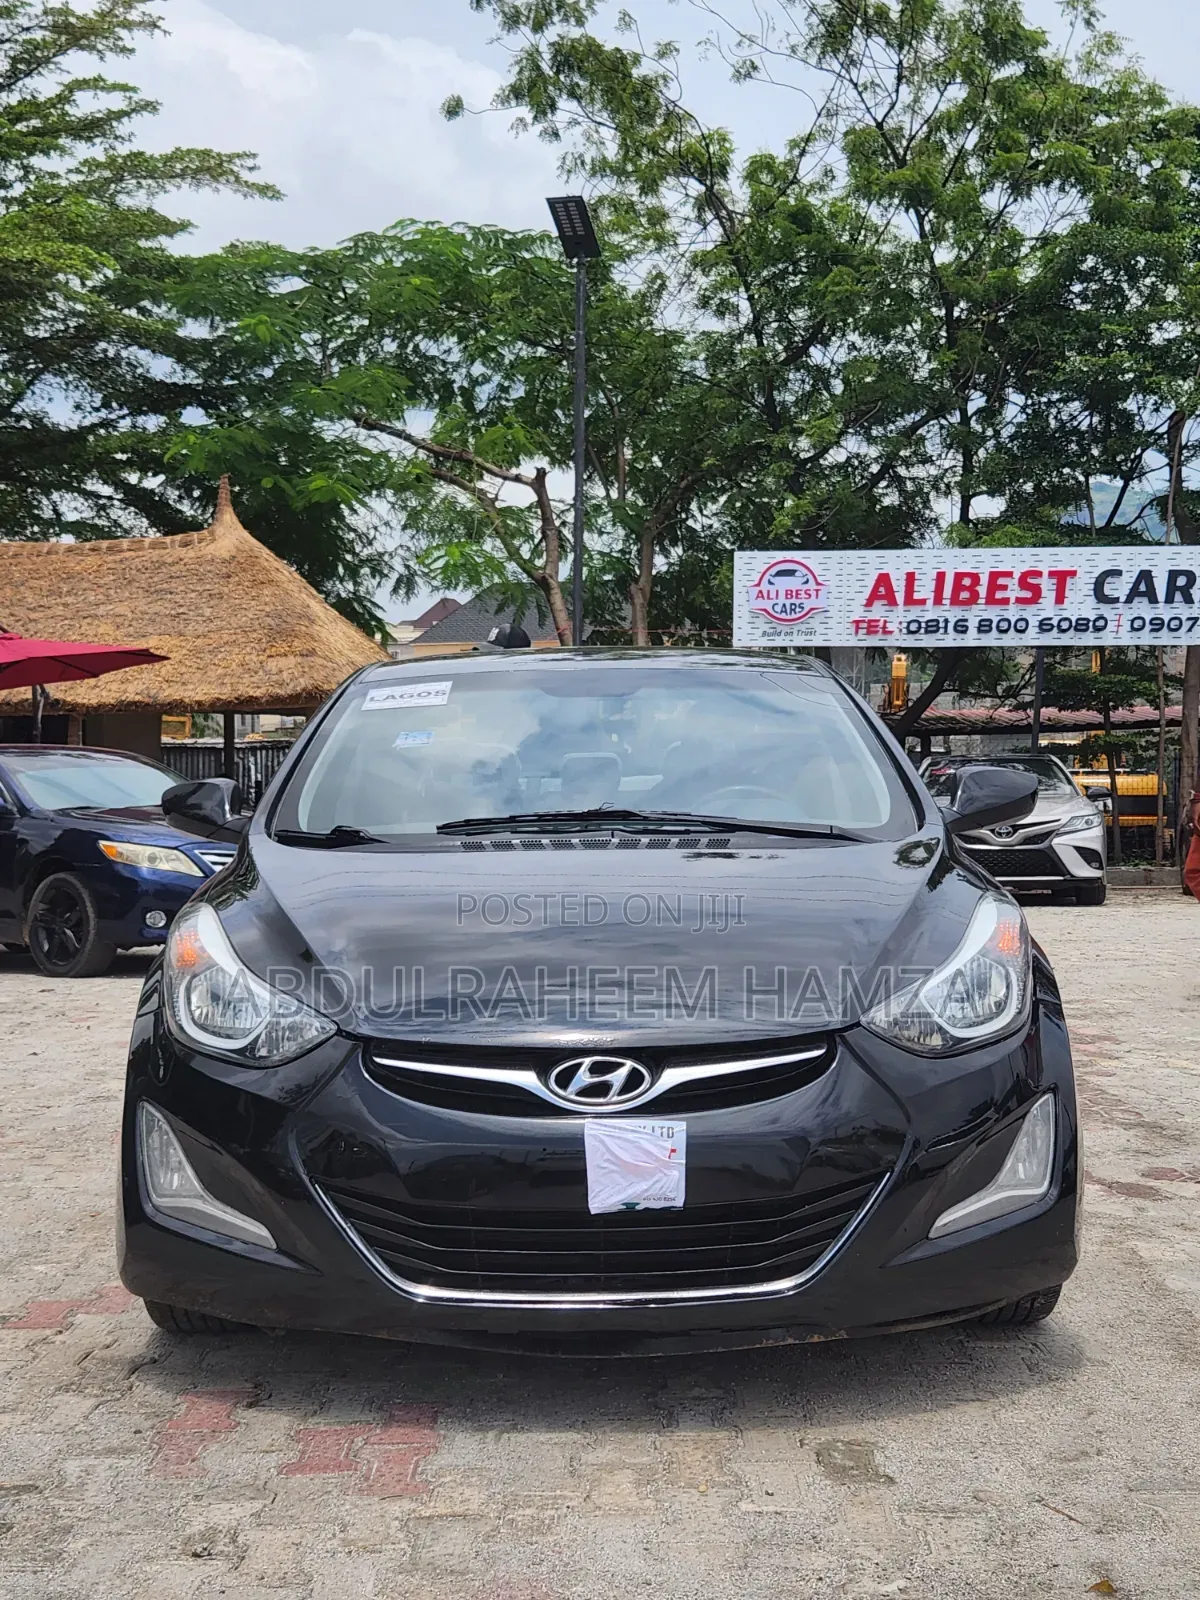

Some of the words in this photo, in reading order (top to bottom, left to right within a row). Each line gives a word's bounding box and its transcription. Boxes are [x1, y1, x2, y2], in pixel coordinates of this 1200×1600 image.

[864, 570, 1078, 607] ALIBEST
[1093, 568, 1200, 605] CAR
[755, 589, 779, 601] ALI
[785, 588, 822, 600] BEST
[772, 602, 805, 616] CARS
[906, 617, 969, 636] 0816
[976, 617, 1030, 635] 800
[1038, 616, 1109, 634] 6080
[761, 629, 781, 638] Build
[796, 629, 817, 637] Trust
[369, 690, 447, 702] LAGOS
